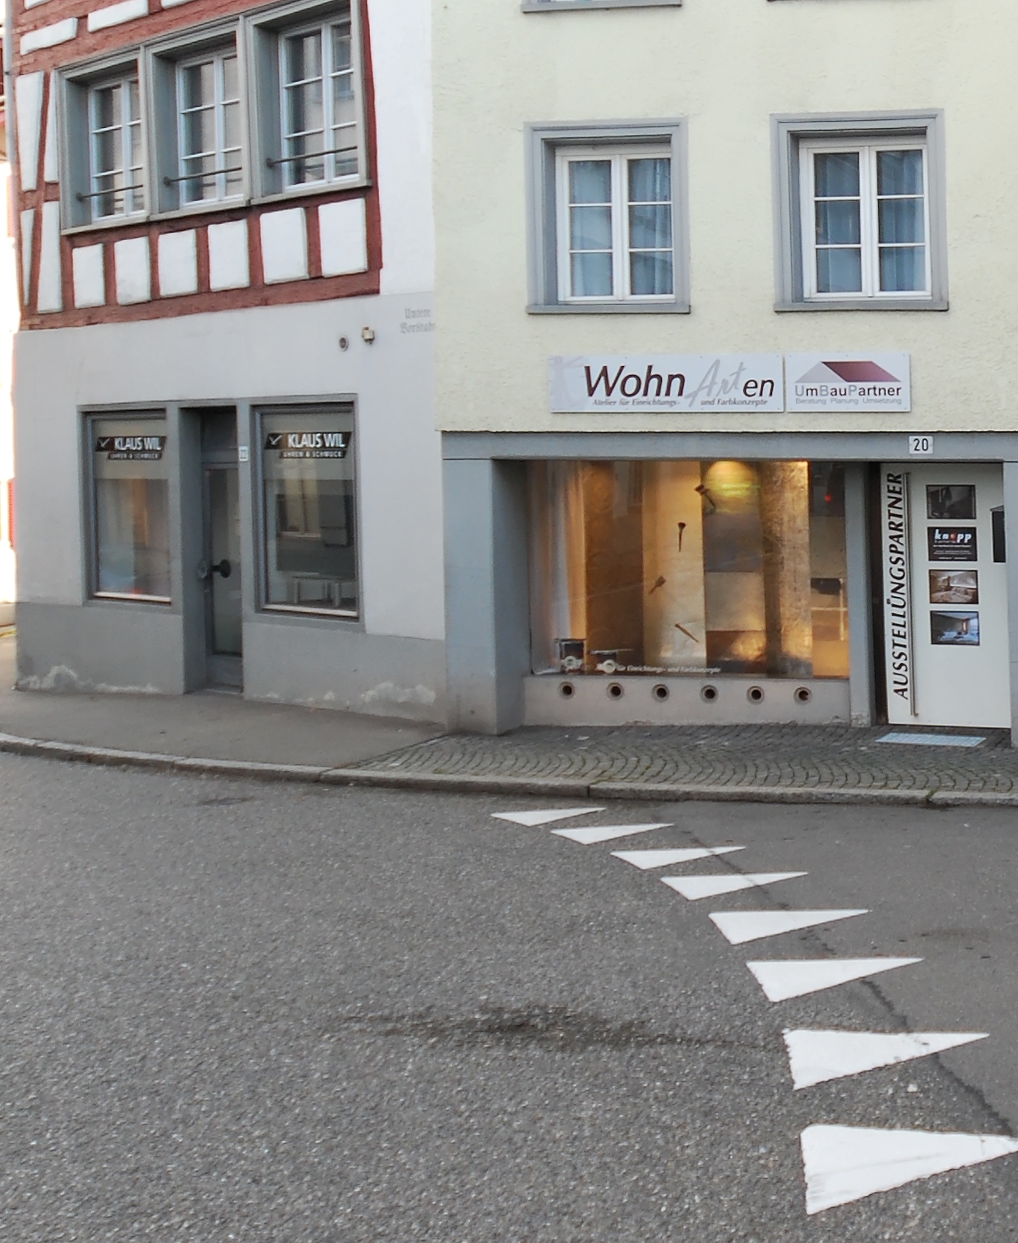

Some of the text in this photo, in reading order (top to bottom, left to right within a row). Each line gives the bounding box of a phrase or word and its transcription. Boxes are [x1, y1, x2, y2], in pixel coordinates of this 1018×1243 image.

[795, 384, 902, 397] UmBauPartner
[620, 399, 630, 407] für
[114, 437, 161, 451] KLAUS WIL
[287, 433, 345, 448] KLAUS WIL
[913, 438, 928, 451] 20
